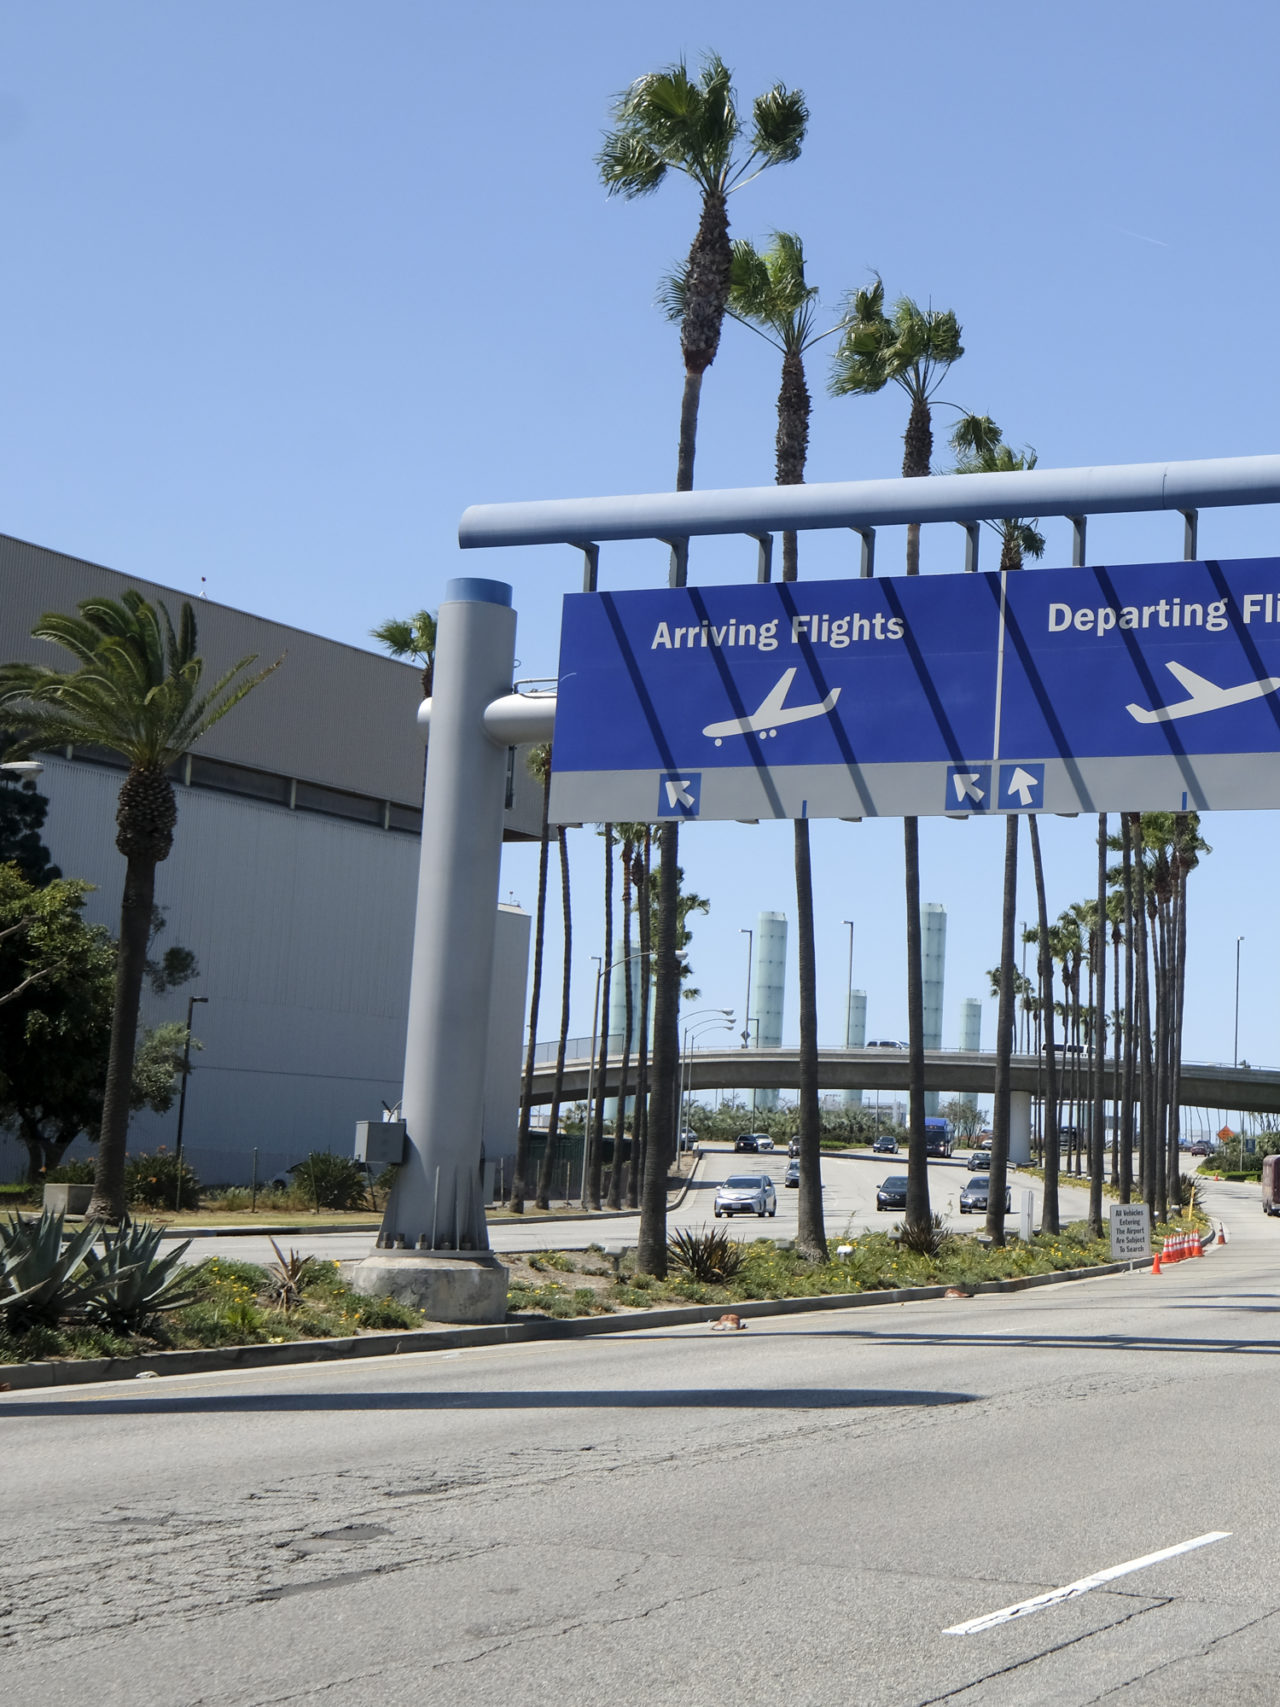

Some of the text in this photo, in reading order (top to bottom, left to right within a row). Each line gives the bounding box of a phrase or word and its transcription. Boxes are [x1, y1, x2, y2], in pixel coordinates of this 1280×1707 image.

[1048, 597, 1228, 637] Departing
[650, 612, 906, 651] Arriving Flights
[1123, 1209, 1144, 1217] Vehicles
[1126, 1227, 1145, 1235] Airport
[1125, 1236, 1145, 1244] Subject
[1126, 1245, 1145, 1253] Search
